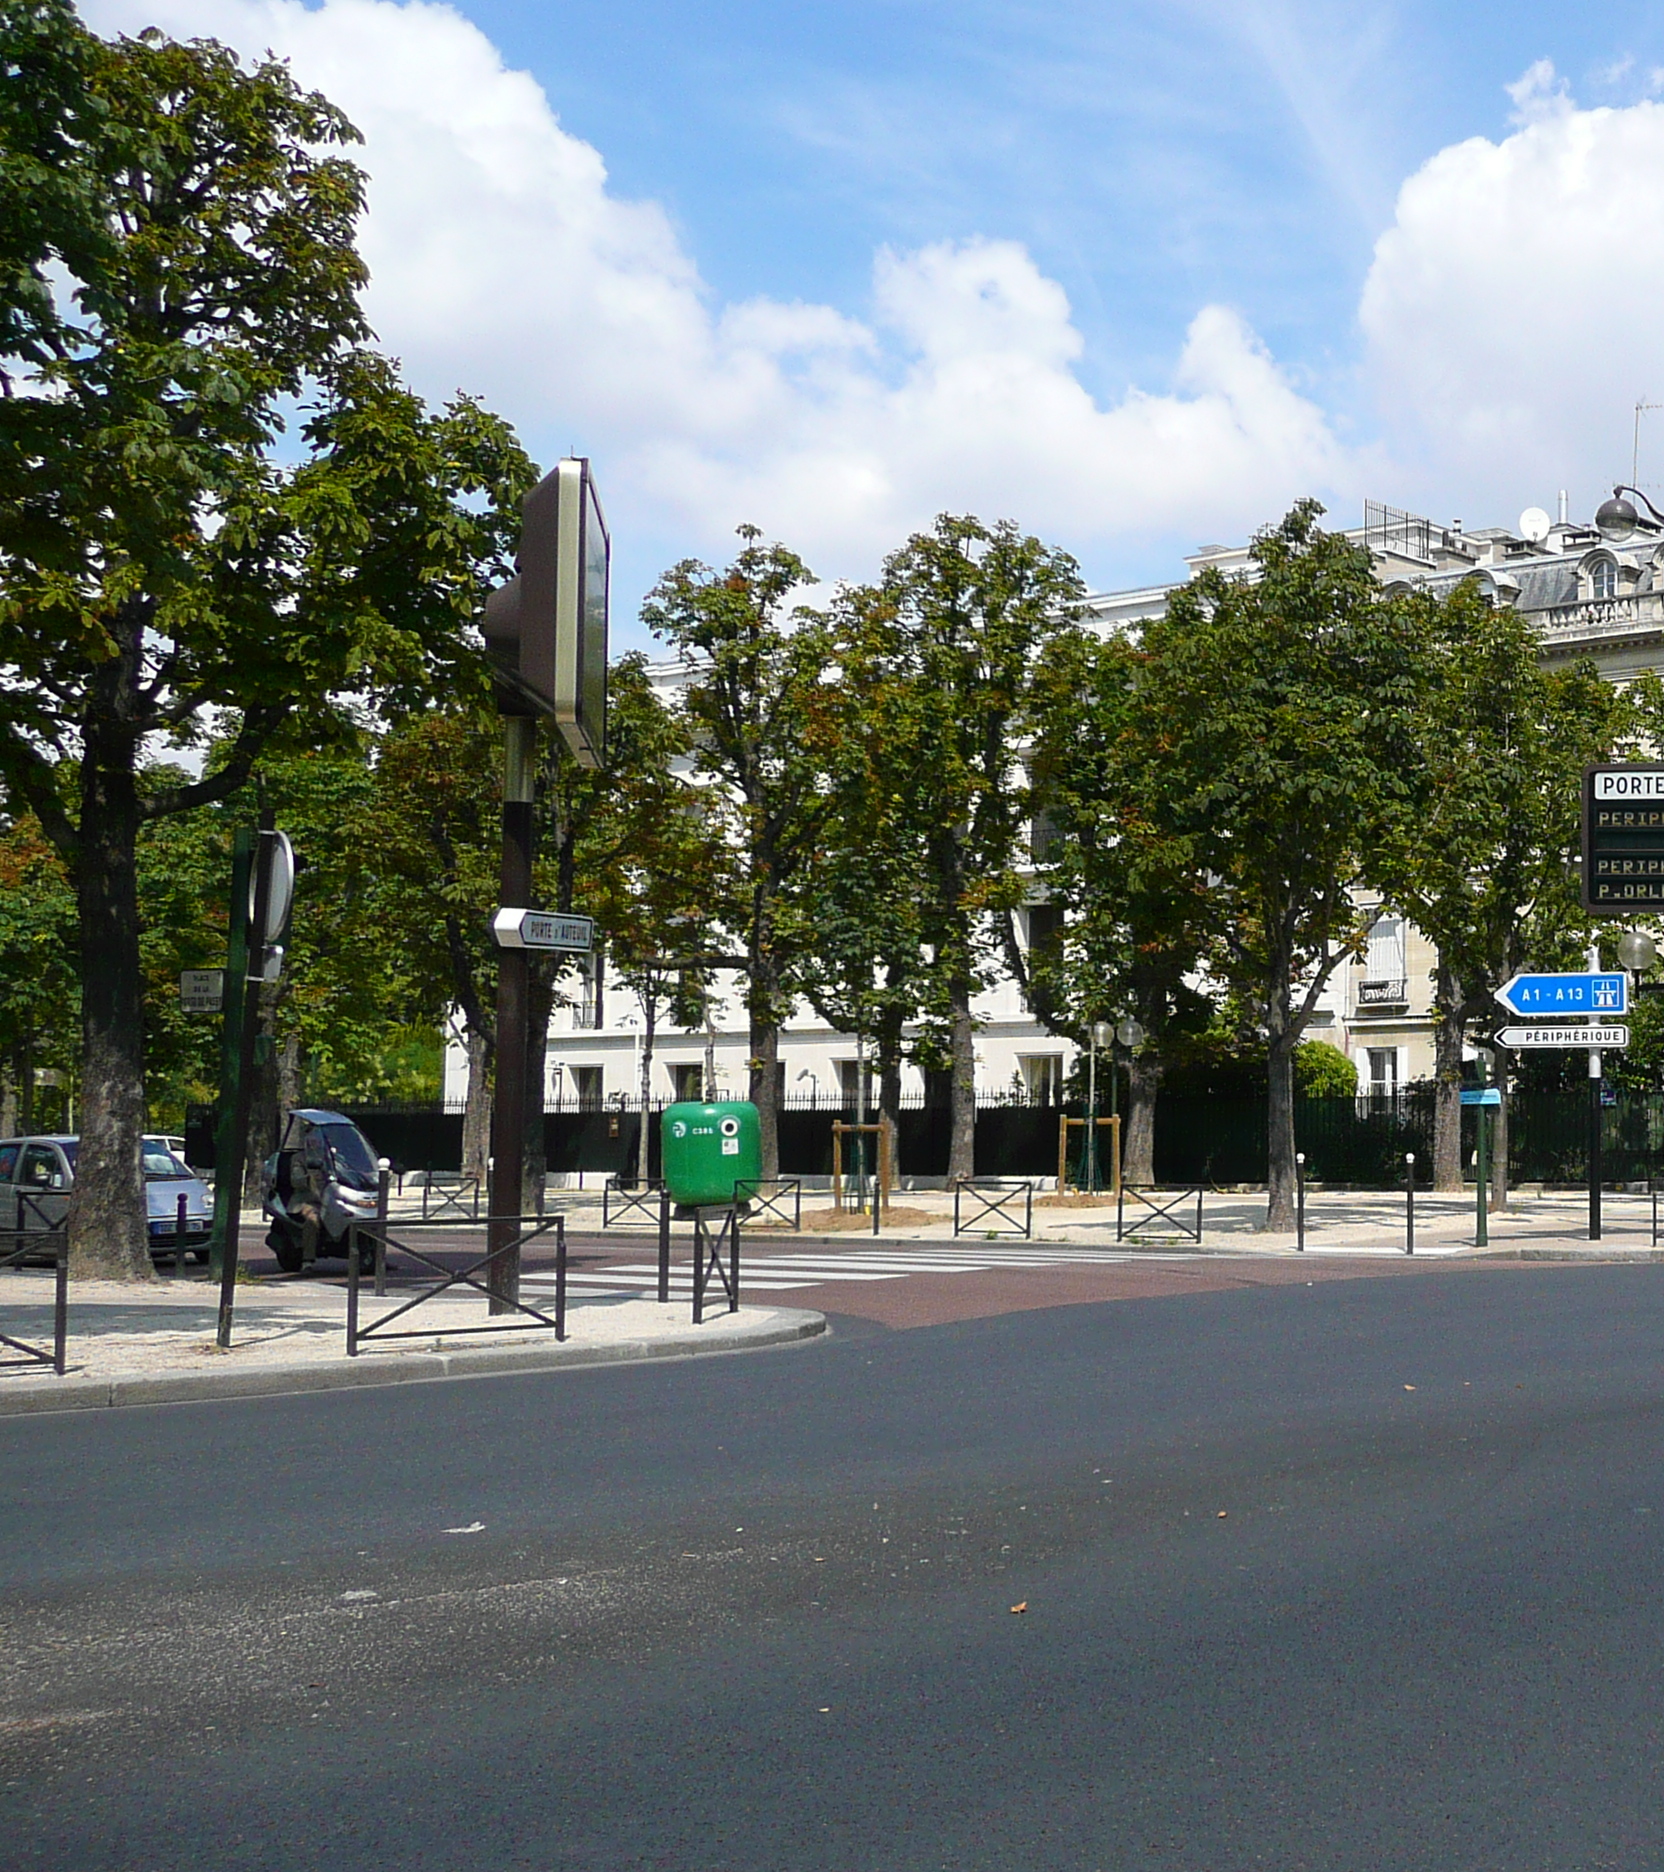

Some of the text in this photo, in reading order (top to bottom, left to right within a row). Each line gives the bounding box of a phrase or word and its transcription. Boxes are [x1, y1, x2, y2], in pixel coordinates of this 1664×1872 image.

[1603, 775, 1664, 795] PORTE
[531, 921, 552, 939] PORTE
[1525, 1028, 1621, 1043] PÉRIPHÉRIQUE
